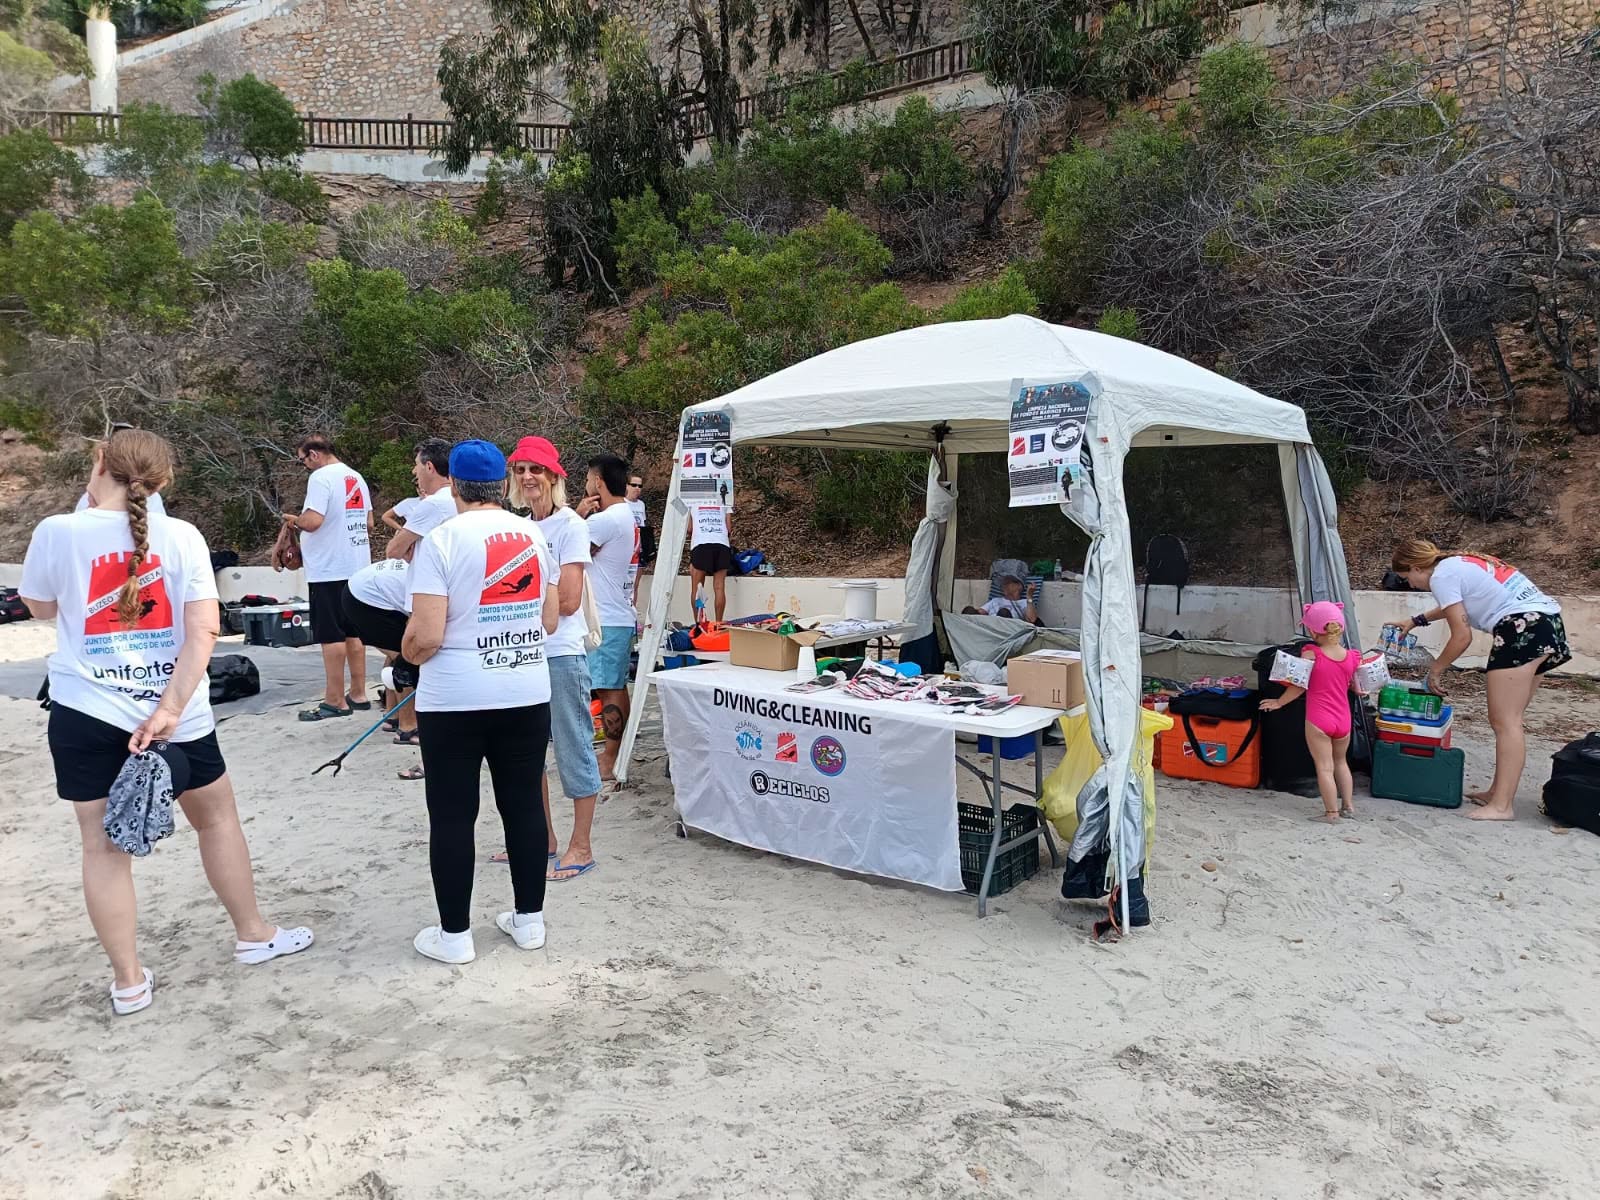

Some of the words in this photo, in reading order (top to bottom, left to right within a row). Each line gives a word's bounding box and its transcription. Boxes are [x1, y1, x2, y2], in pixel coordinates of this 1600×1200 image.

[485, 571, 504, 587] BUZEO
[88, 595, 114, 615] BUZEO
[478, 606, 501, 614] JUNTOS
[514, 603, 528, 611] UNOS
[478, 615, 501, 623] LIMPIOS
[507, 612, 527, 620] LLENOS
[85, 637, 113, 646] JUNTOS
[113, 634, 128, 642] POR
[129, 632, 149, 641] UNOS
[150, 629, 173, 639] MARES
[477, 626, 543, 649] unifortel
[85, 646, 115, 655] LIMPIOS
[150, 641, 160, 649] DE
[161, 640, 175, 648] VIDA
[713, 688, 872, 735] DIVING&CLEANING
[750, 770, 830, 803] RECICLOS
